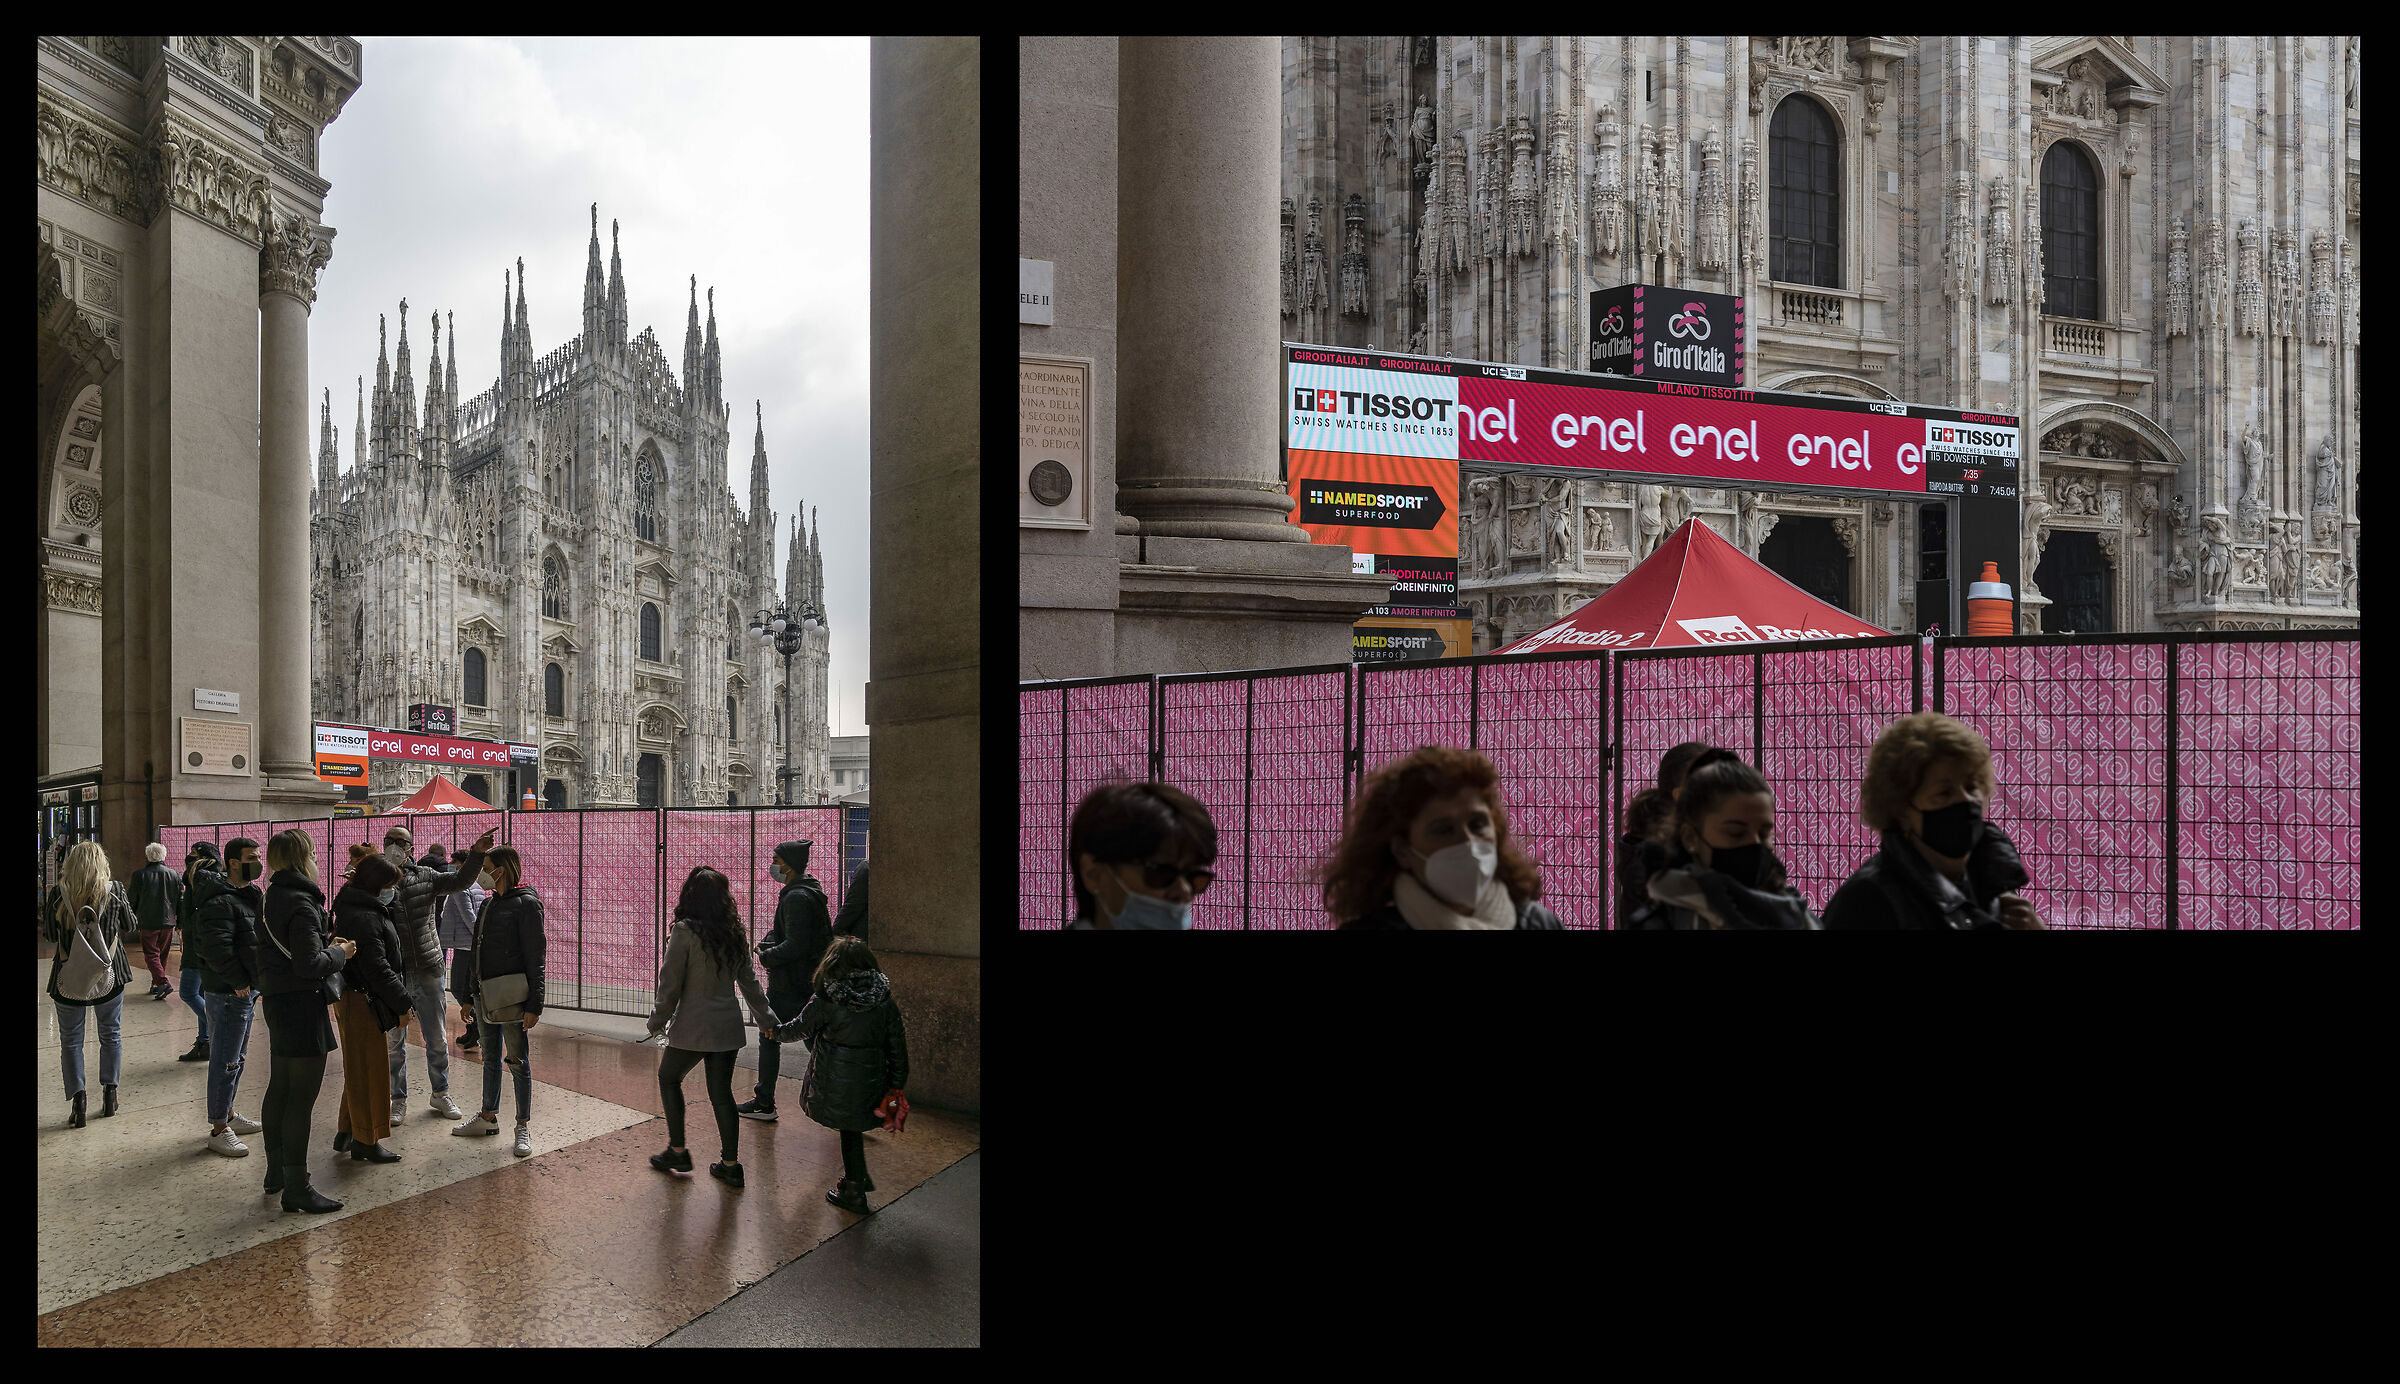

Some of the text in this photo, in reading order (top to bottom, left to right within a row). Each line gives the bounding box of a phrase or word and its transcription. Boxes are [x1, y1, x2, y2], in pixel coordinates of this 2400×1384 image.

[1042, 295, 1050, 306] II
[1592, 337, 1632, 361] Giro d'Italia
[1294, 350, 1370, 366] GIRODITALIA.IT
[1654, 340, 1726, 374] Giro d'Italia
[1380, 358, 1452, 374] GIRODITALIA.IT
[1482, 366, 1498, 376] UCI
[1657, 382, 1755, 401] MILANO TISSOT ITT
[1049, 399, 1081, 410] DELLA
[1340, 391, 1453, 422] TISSOT
[1869, 403, 1883, 412] UCI
[1028, 411, 1066, 422] SECOLO
[1068, 414, 1081, 423] HA
[1961, 412, 2015, 425] GIRODITALIA.IT
[1043, 425, 1081, 437] GRANDI
[1294, 416, 1454, 437] SWISS WATCHES SINCE 1853
[1551, 410, 1647, 454] enel
[1042, 439, 1081, 450] DEDICA
[1669, 420, 1760, 463] enel
[1955, 429, 2015, 448] TISSOT
[1787, 430, 1872, 471] enel
[1953, 446, 1981, 454] WATCHES
[1930, 452, 2015, 467] 115 DOWSETT A. ISN
[1964, 469, 1979, 479] 7:35
[1970, 484, 1978, 494] 10
[1990, 485, 2016, 496] 7:45.04
[1335, 509, 1400, 520] SUPERFOOD
[1390, 582, 1455, 593] OREINFINITO
[1375, 607, 1389, 615] 103
[1391, 607, 1420, 616] AMORE
[1421, 608, 1457, 617] INFINITO
[1547, 627, 1623, 646] Radio
[1615, 632, 1646, 646] 2
[1694, 626, 1754, 644] Rai
[1353, 636, 1428, 649] AMEDSPORT
[332, 735, 367, 745] TISSOT
[371, 739, 402, 753] enel
[411, 743, 440, 757] enel
[447, 745, 475, 760] enel
[483, 749, 508, 763] enel
